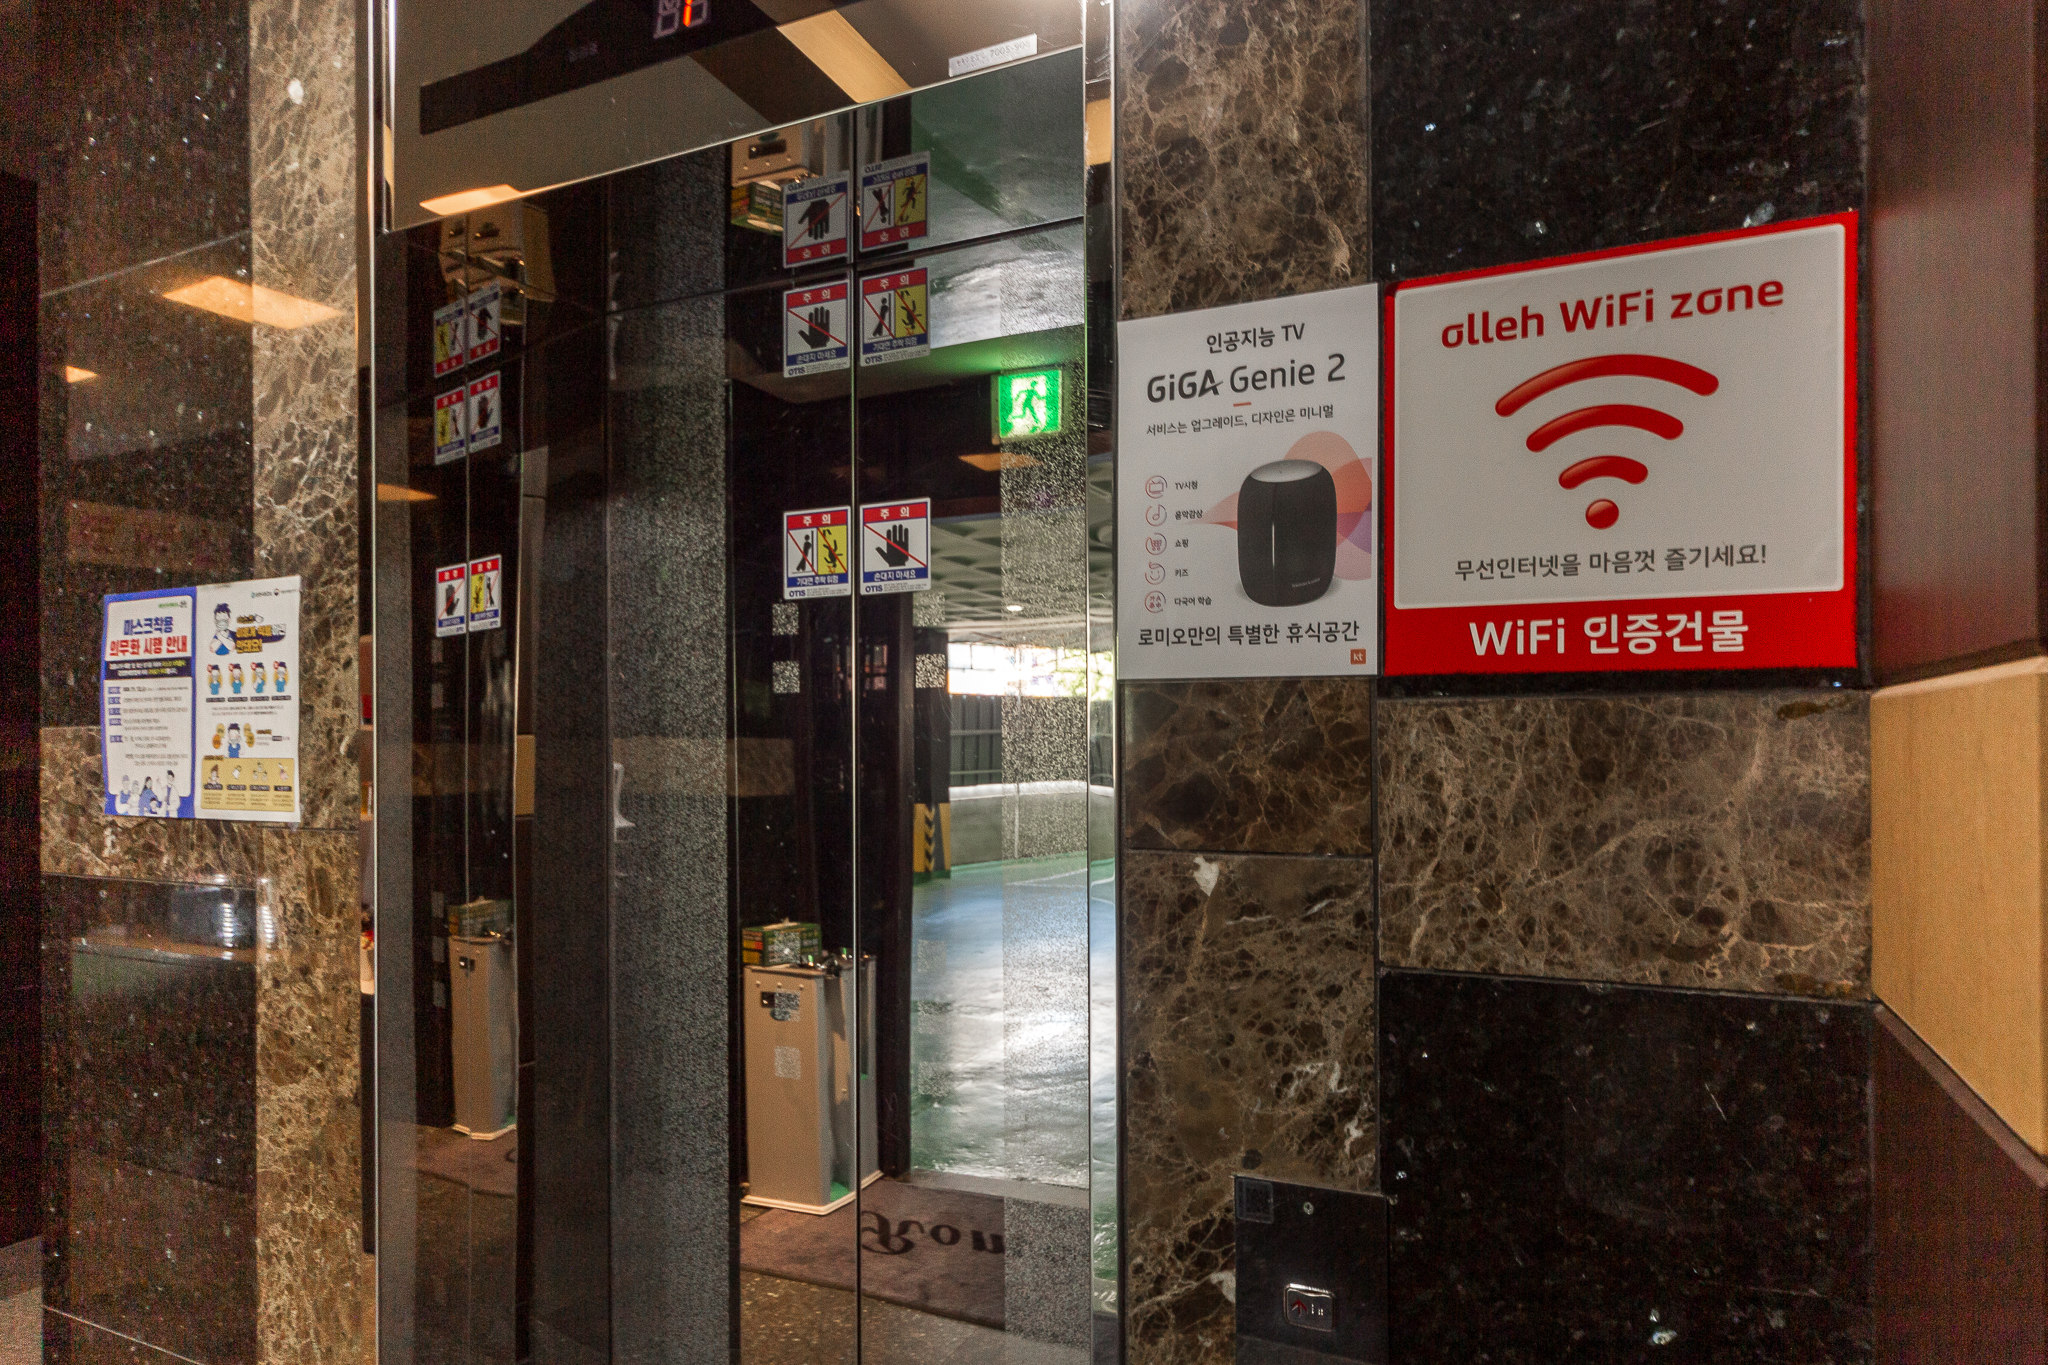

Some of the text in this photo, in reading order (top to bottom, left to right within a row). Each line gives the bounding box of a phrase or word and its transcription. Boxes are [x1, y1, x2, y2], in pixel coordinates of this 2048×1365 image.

[1441, 279, 1785, 349] olleh WiFi zone
[1207, 323, 1306, 354] 인공지능 TV
[1147, 353, 1346, 403] GiGA Genie 2
[1146, 404, 1334, 436] 서비스는 업그레이드, 디자인은 미니멀
[1174, 480, 1198, 490] TV시청
[1174, 509, 1203, 520] 음악감상
[1174, 539, 1189, 548] 쇼핑
[1454, 544, 1768, 582] 무선인터넷을 마음껏 즐기세요!
[874, 569, 916, 581] 손대지 마세요
[1174, 569, 1189, 578] 키즈
[789, 590, 806, 598] OTIS
[865, 585, 883, 593] OTIS
[1174, 596, 1212, 606] 다국어 학습
[1138, 620, 1360, 647] 로미오만의 특별한 휴식공간
[1468, 610, 1749, 657] WiFi 인증건물
[1353, 652, 1364, 661] kt
